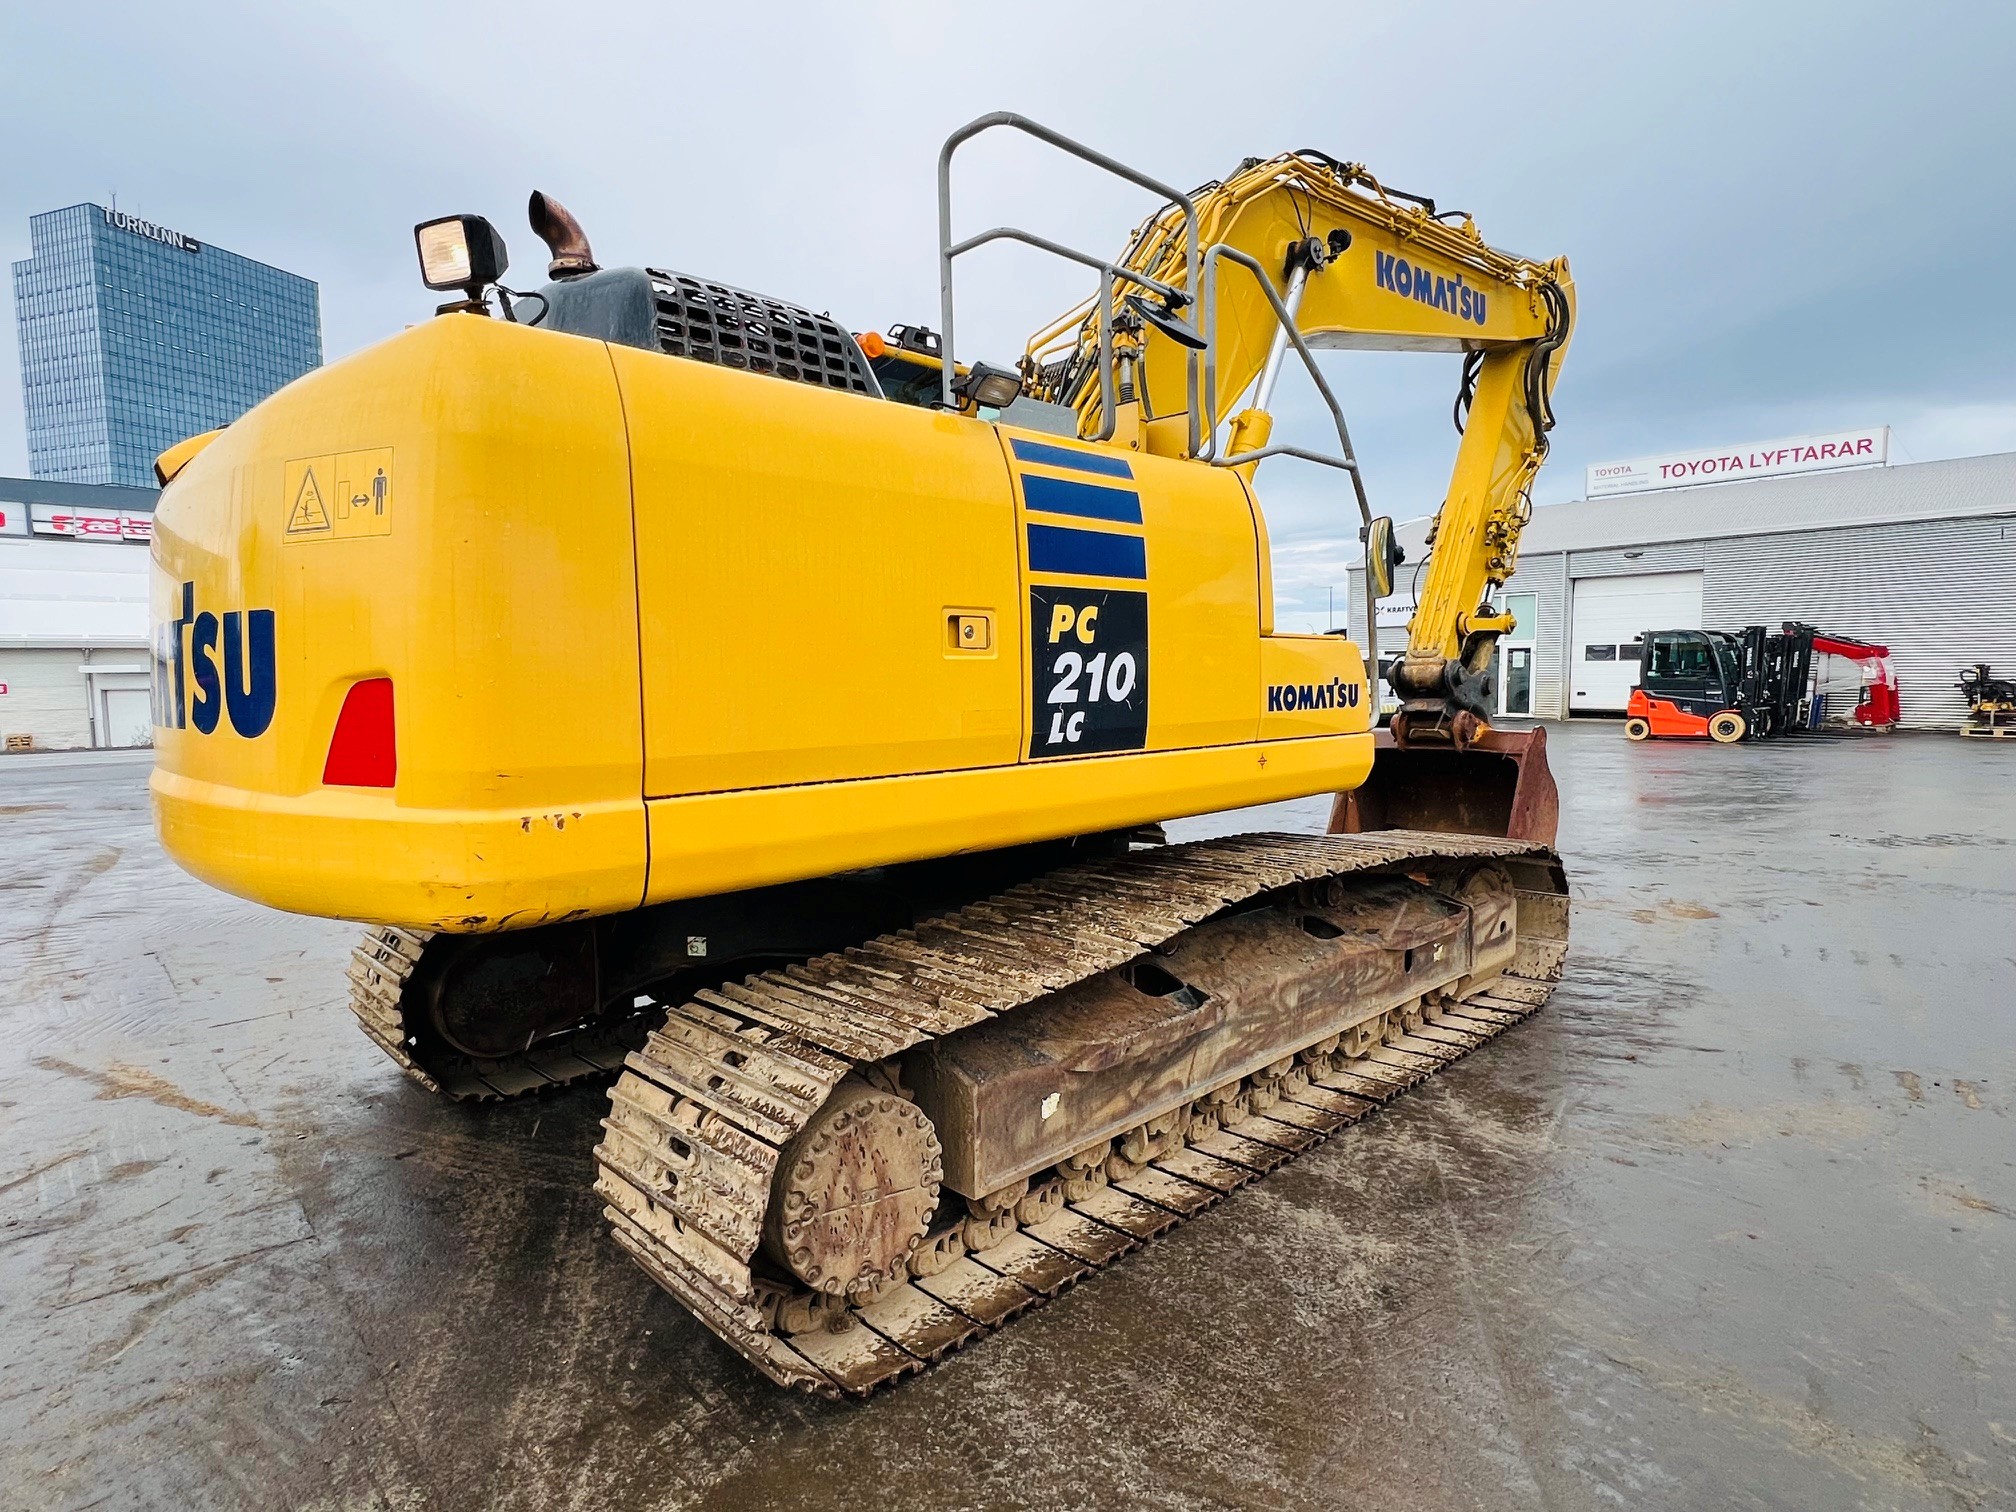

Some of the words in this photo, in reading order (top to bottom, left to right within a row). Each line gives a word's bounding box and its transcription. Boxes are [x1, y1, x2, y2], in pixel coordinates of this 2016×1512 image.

[102, 207, 184, 248] TURNINN
[1376, 250, 1486, 325] KOMATSU
[1595, 466, 1632, 476] TOYOTA
[1659, 456, 1743, 479] TOYOTA
[1749, 438, 1873, 468] LYFTARAR
[1049, 604, 1098, 644] PC
[1386, 605, 1417, 613] KRAFTV
[1047, 651, 1136, 704] 210
[1268, 677, 1358, 712] KOMATSU
[1047, 711, 1085, 744] LC
